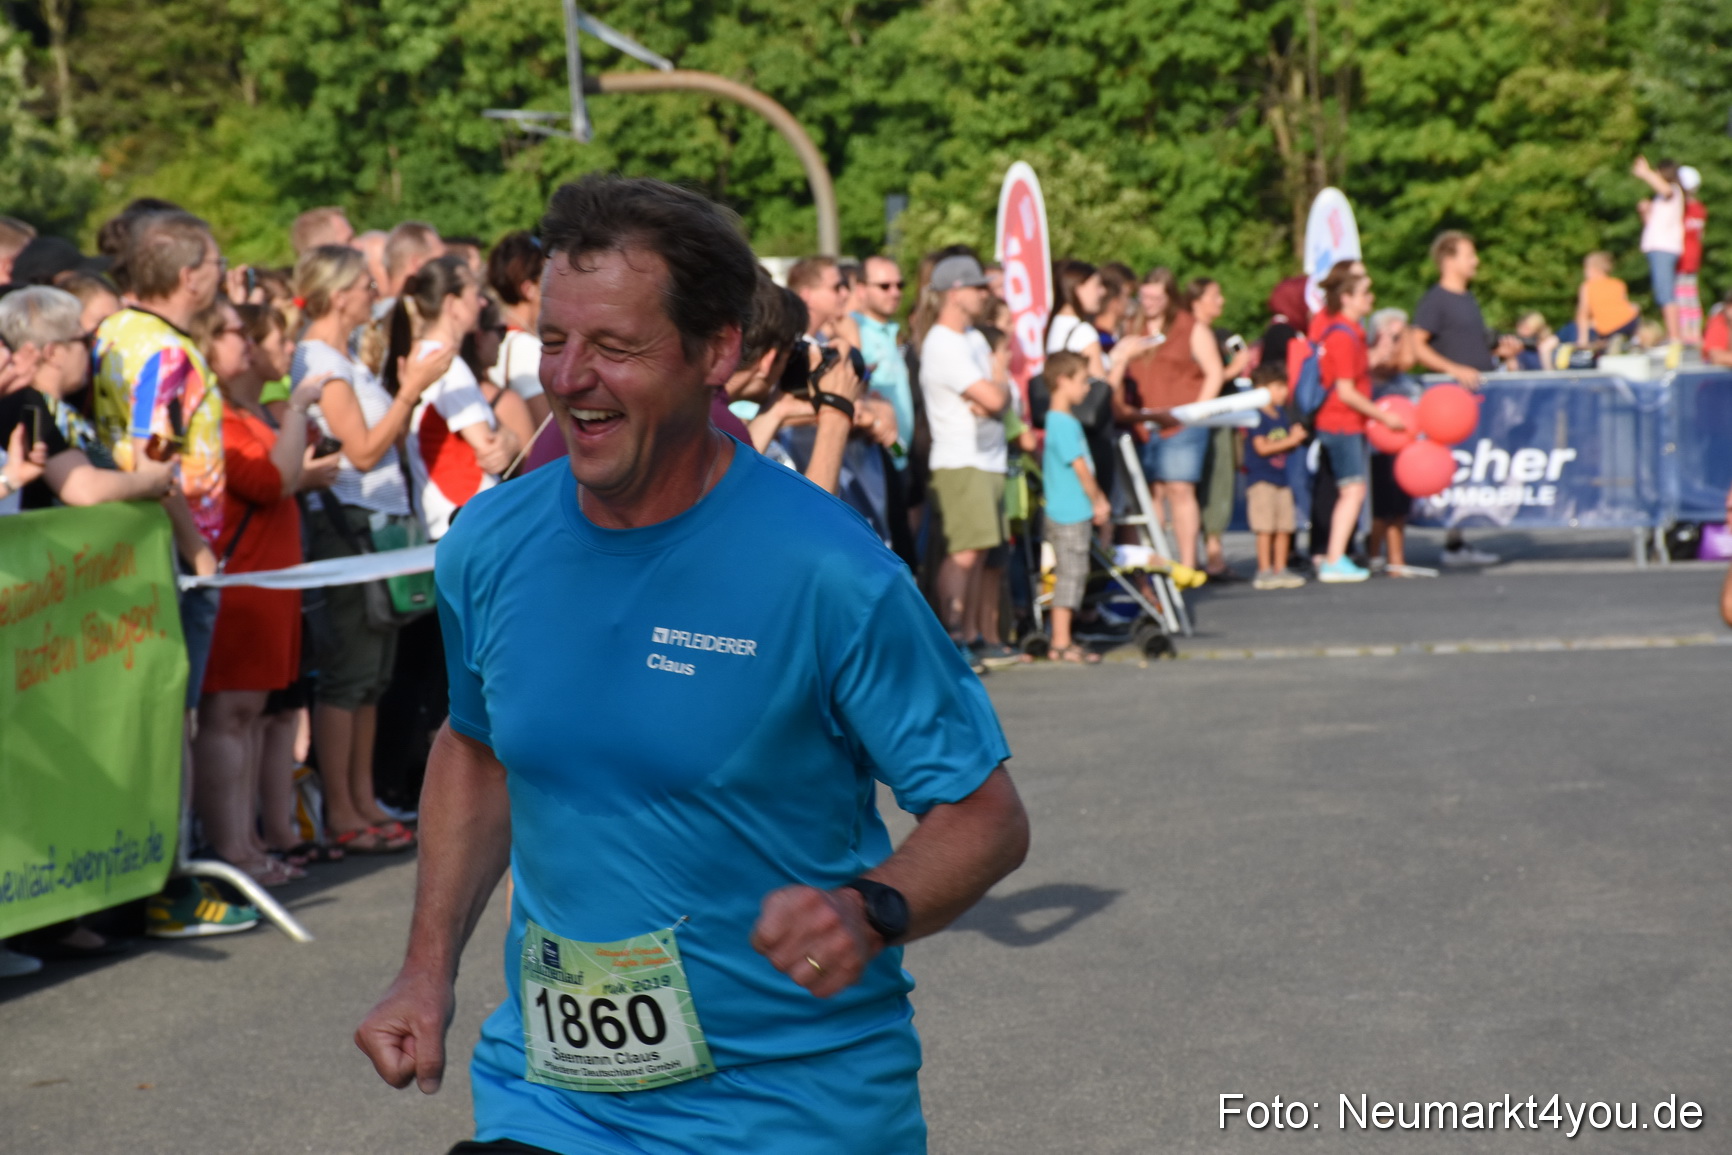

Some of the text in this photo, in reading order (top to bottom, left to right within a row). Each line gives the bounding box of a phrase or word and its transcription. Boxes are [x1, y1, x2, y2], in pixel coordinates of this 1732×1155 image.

[668, 629, 758, 657] PFLEIDERER
[646, 653, 696, 676] Claus
[631, 974, 671, 993] 2019
[536, 987, 667, 1050] 1860
[552, 1048, 661, 1065] Seemann Claus
